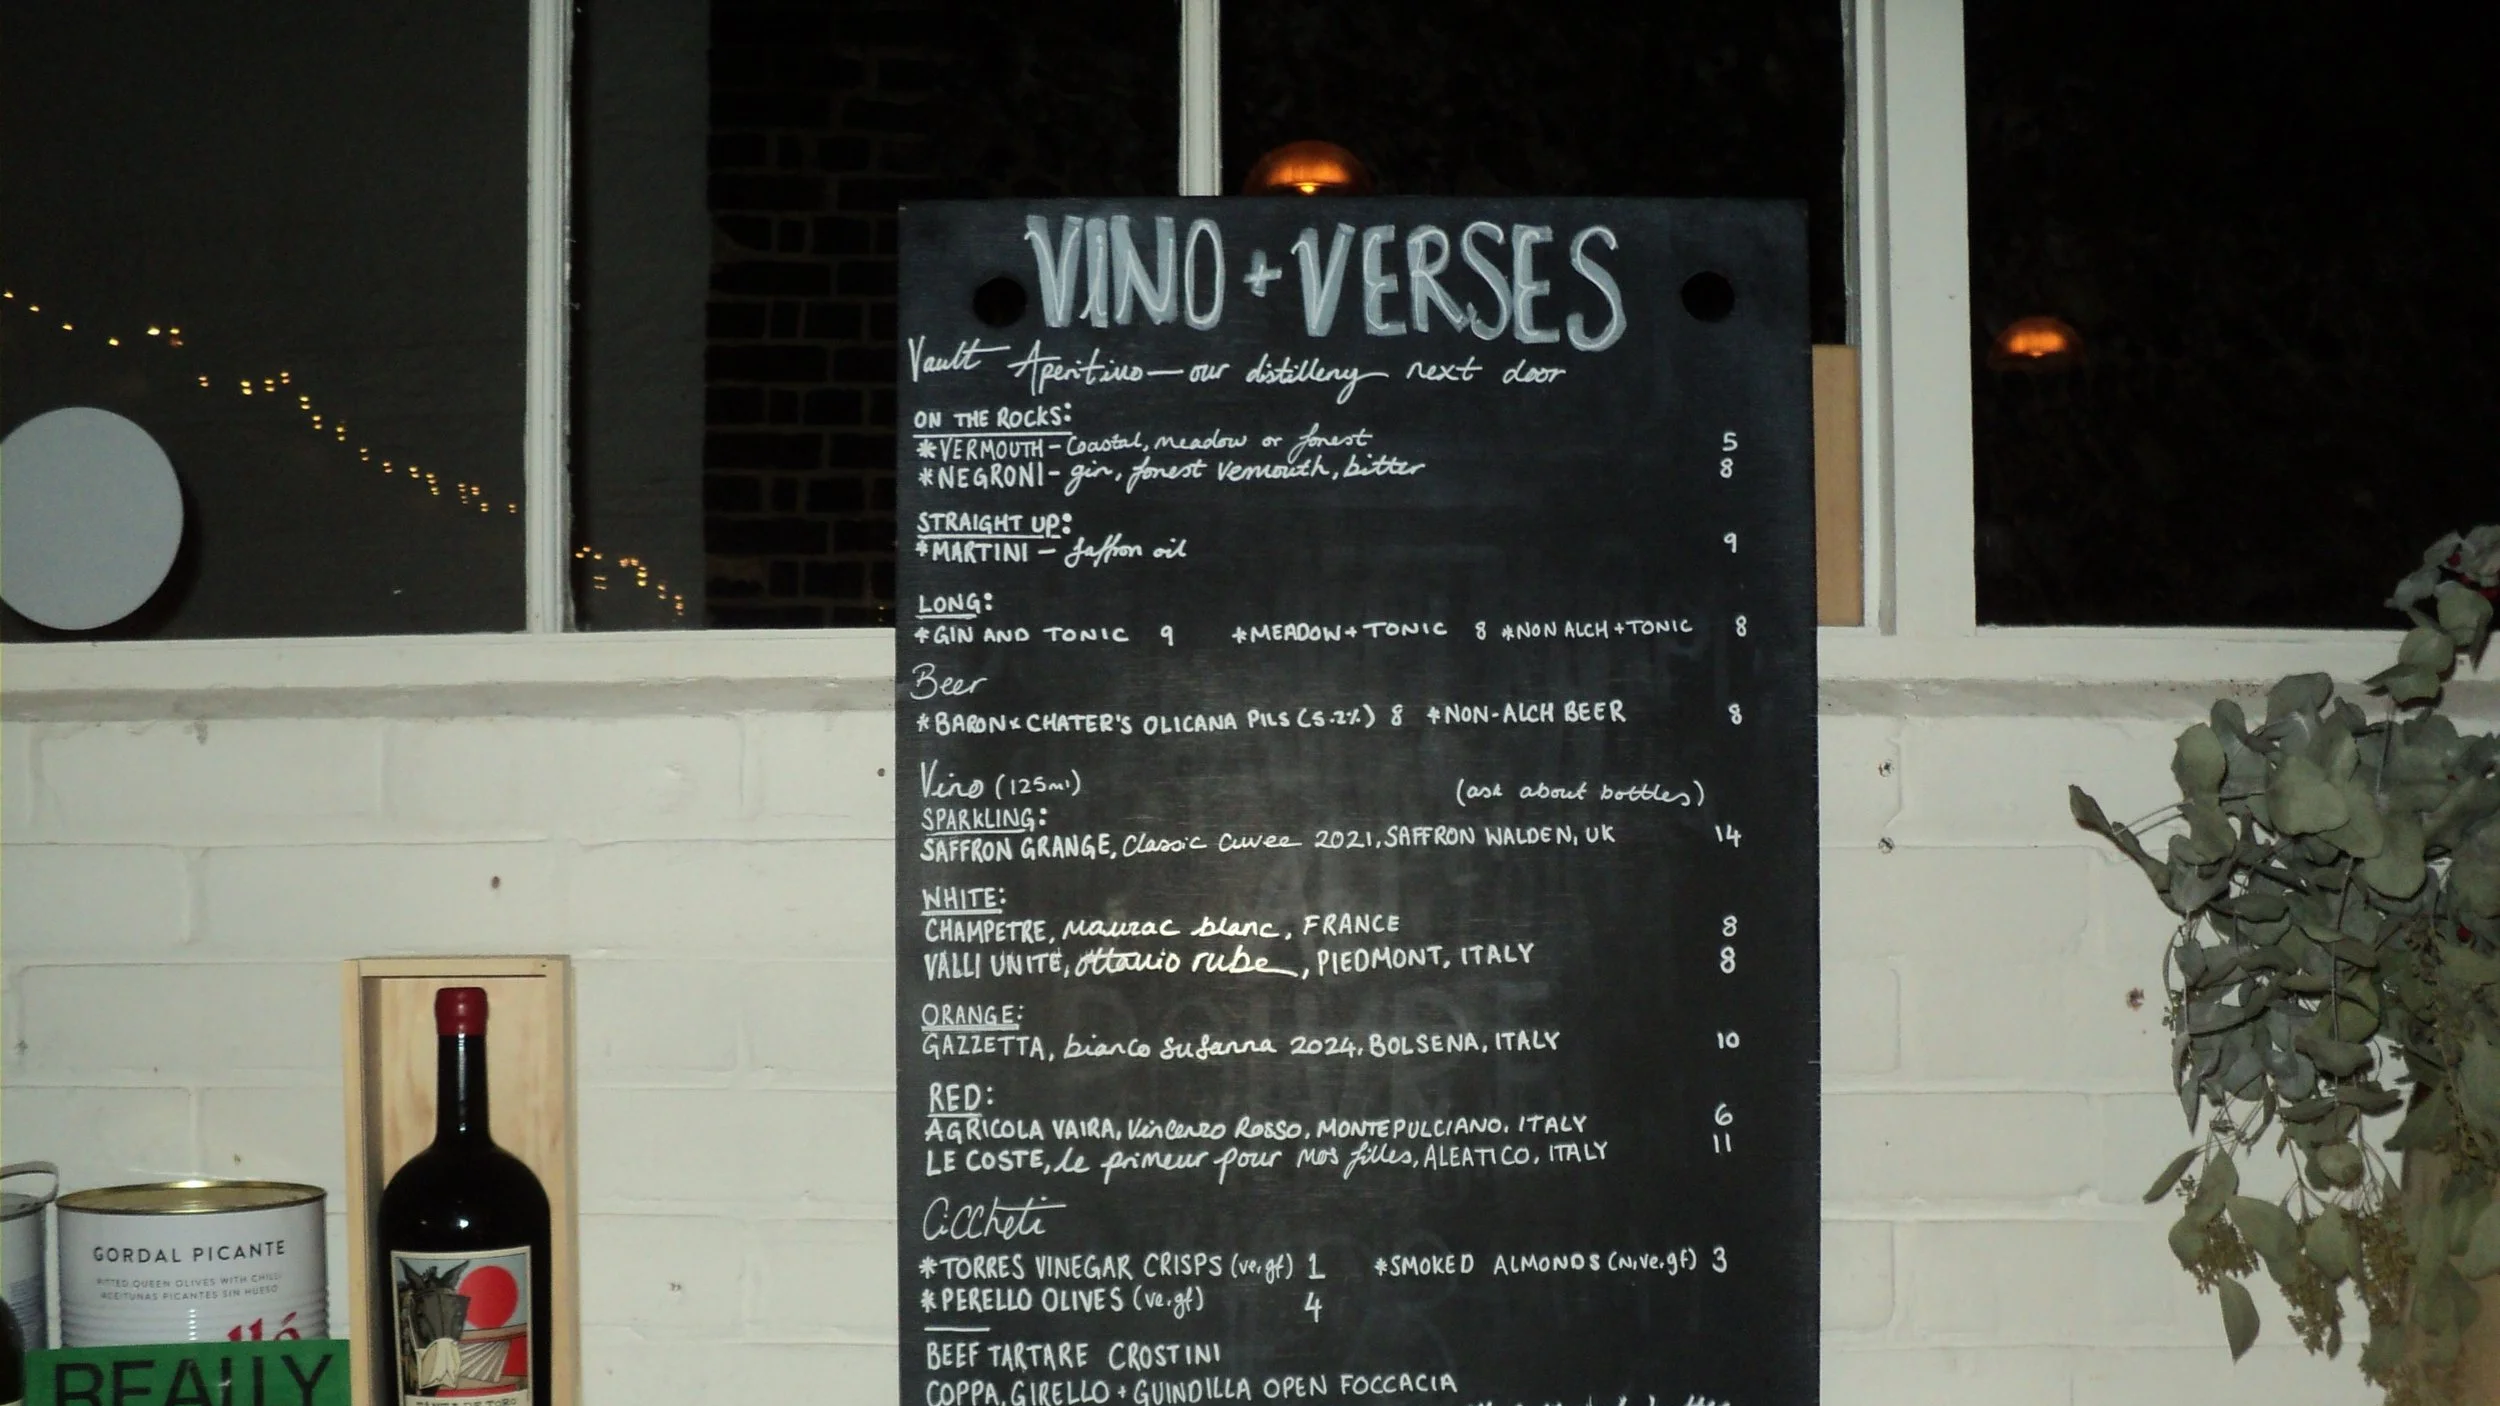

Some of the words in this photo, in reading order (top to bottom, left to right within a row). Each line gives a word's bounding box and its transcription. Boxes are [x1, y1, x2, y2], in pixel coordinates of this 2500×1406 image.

[1026, 214, 1225, 329] VINO
[1291, 221, 1628, 353] VERSES
[908, 336, 1011, 382] Vault
[1245, 353, 1389, 404] distillery
[1406, 356, 1483, 383] next
[1502, 359, 1566, 384] door
[914, 412, 941, 428] ON
[954, 410, 989, 427] THE
[997, 403, 1072, 428] ROCKS:
[940, 440, 1043, 461] VERMOUTH
[1155, 429, 1247, 450] meadow
[1263, 435, 1282, 447] or
[1288, 422, 1373, 463] forest
[1722, 431, 1738, 452] 5
[938, 463, 1043, 488] NEGRONI
[1126, 456, 1207, 493] forest
[1343, 452, 1425, 478] bitter
[1720, 459, 1734, 479] 8
[917, 513, 1023, 533] STRAIGHT
[1031, 513, 1072, 538] UP:
[932, 543, 1028, 563] MARTINI
[1152, 539, 1187, 558] oil
[1724, 532, 1738, 554] 9
[918, 592, 993, 614] LONG:
[933, 627, 974, 643] GIN
[983, 628, 1030, 642] AND
[1042, 627, 1130, 642] TONIC
[1160, 625, 1174, 646] 9
[1363, 622, 1448, 637] TONIC
[1475, 622, 1487, 640] 8
[1517, 621, 1558, 639] NON
[1564, 620, 1608, 638] ALCH
[1736, 616, 1747, 636] 8
[910, 663, 989, 700] Beer
[1026, 712, 1133, 735] CHATER'S
[1143, 714, 1237, 735] OLICANA
[1247, 709, 1290, 728] PILS
[1391, 704, 1403, 727] 8
[1443, 701, 1554, 724] NON-ALCH
[1564, 700, 1627, 723] BEER
[1730, 705, 1742, 724] 8
[920, 760, 984, 799] Vino
[1456, 778, 1503, 805] (ask
[1520, 781, 1587, 800] about
[1600, 781, 1705, 806] bottles)
[921, 808, 1048, 832] SPARKLING:
[920, 837, 1013, 863] SAFFRON
[1020, 833, 1116, 860] GRANGE,
[1314, 829, 1382, 849] 2021,
[1386, 826, 1476, 846] SAFFRON
[1484, 824, 1578, 846] WALDEN,
[1585, 824, 1616, 844] UK
[1715, 824, 1741, 847] 14
[922, 886, 1007, 909] WHITE:
[925, 919, 1055, 944] CHAMPETRE,
[1303, 913, 1400, 934] FRANCE
[1721, 915, 1738, 938] 8
[924, 950, 980, 981] VALLI
[1317, 947, 1451, 976] PIEDMONT,
[1461, 943, 1534, 966] ITALY
[1720, 946, 1736, 974] 8
[921, 1004, 1023, 1026] ORANGE:
[921, 1035, 1054, 1062] GAZZETTA,
[1063, 1033, 1151, 1059] bianco
[1369, 1033, 1488, 1057] BOLSENA,
[1495, 1030, 1561, 1051] ITALY
[1717, 1031, 1740, 1050] 10
[929, 1082, 994, 1113] RED:
[1714, 1103, 1732, 1126] 6
[925, 1118, 1044, 1145] AGRICOLA
[1053, 1117, 1121, 1142] VAIRA,
[1517, 1114, 1588, 1135] ITALY
[1713, 1133, 1732, 1154] 11
[926, 1150, 955, 1177] LE
[966, 1149, 1051, 1175] COSTE,
[1214, 1147, 1282, 1185] pour
[1424, 1145, 1540, 1169] ALEATICO,
[1549, 1142, 1608, 1163] ITALY
[93, 1246, 182, 1263] GORDAL
[193, 1239, 285, 1262] PICANTE
[1391, 1253, 1474, 1276] SMOKED
[1494, 1253, 1600, 1276] ALMONDS
[1712, 1246, 1728, 1273] 3
[940, 1253, 1025, 1280] TORRES
[1035, 1254, 1134, 1281] VINEGAR
[1143, 1252, 1222, 1279] CRISPS
[1308, 1253, 1325, 1280] 1
[133, 1278, 170, 1288] QUEEN
[176, 1278, 216, 1288] OLIVES
[220, 1275, 247, 1284] WITH
[163, 1290, 217, 1300] PICANTES
[222, 1289, 240, 1298] SIN
[942, 1288, 1032, 1312] PERELLO
[1042, 1286, 1124, 1312] OLIVES
[1305, 1292, 1322, 1323] 4
[927, 1342, 979, 1371] BEEF
[987, 1343, 1089, 1373] TARTARE
[1109, 1343, 1220, 1371] CROSTINI
[1011, 1379, 1109, 1406] GIRELLO
[1133, 1377, 1251, 1406] GUINDILLA
[1264, 1375, 1327, 1399] OPEN
[1340, 1374, 1458, 1396] FOCCACIA
